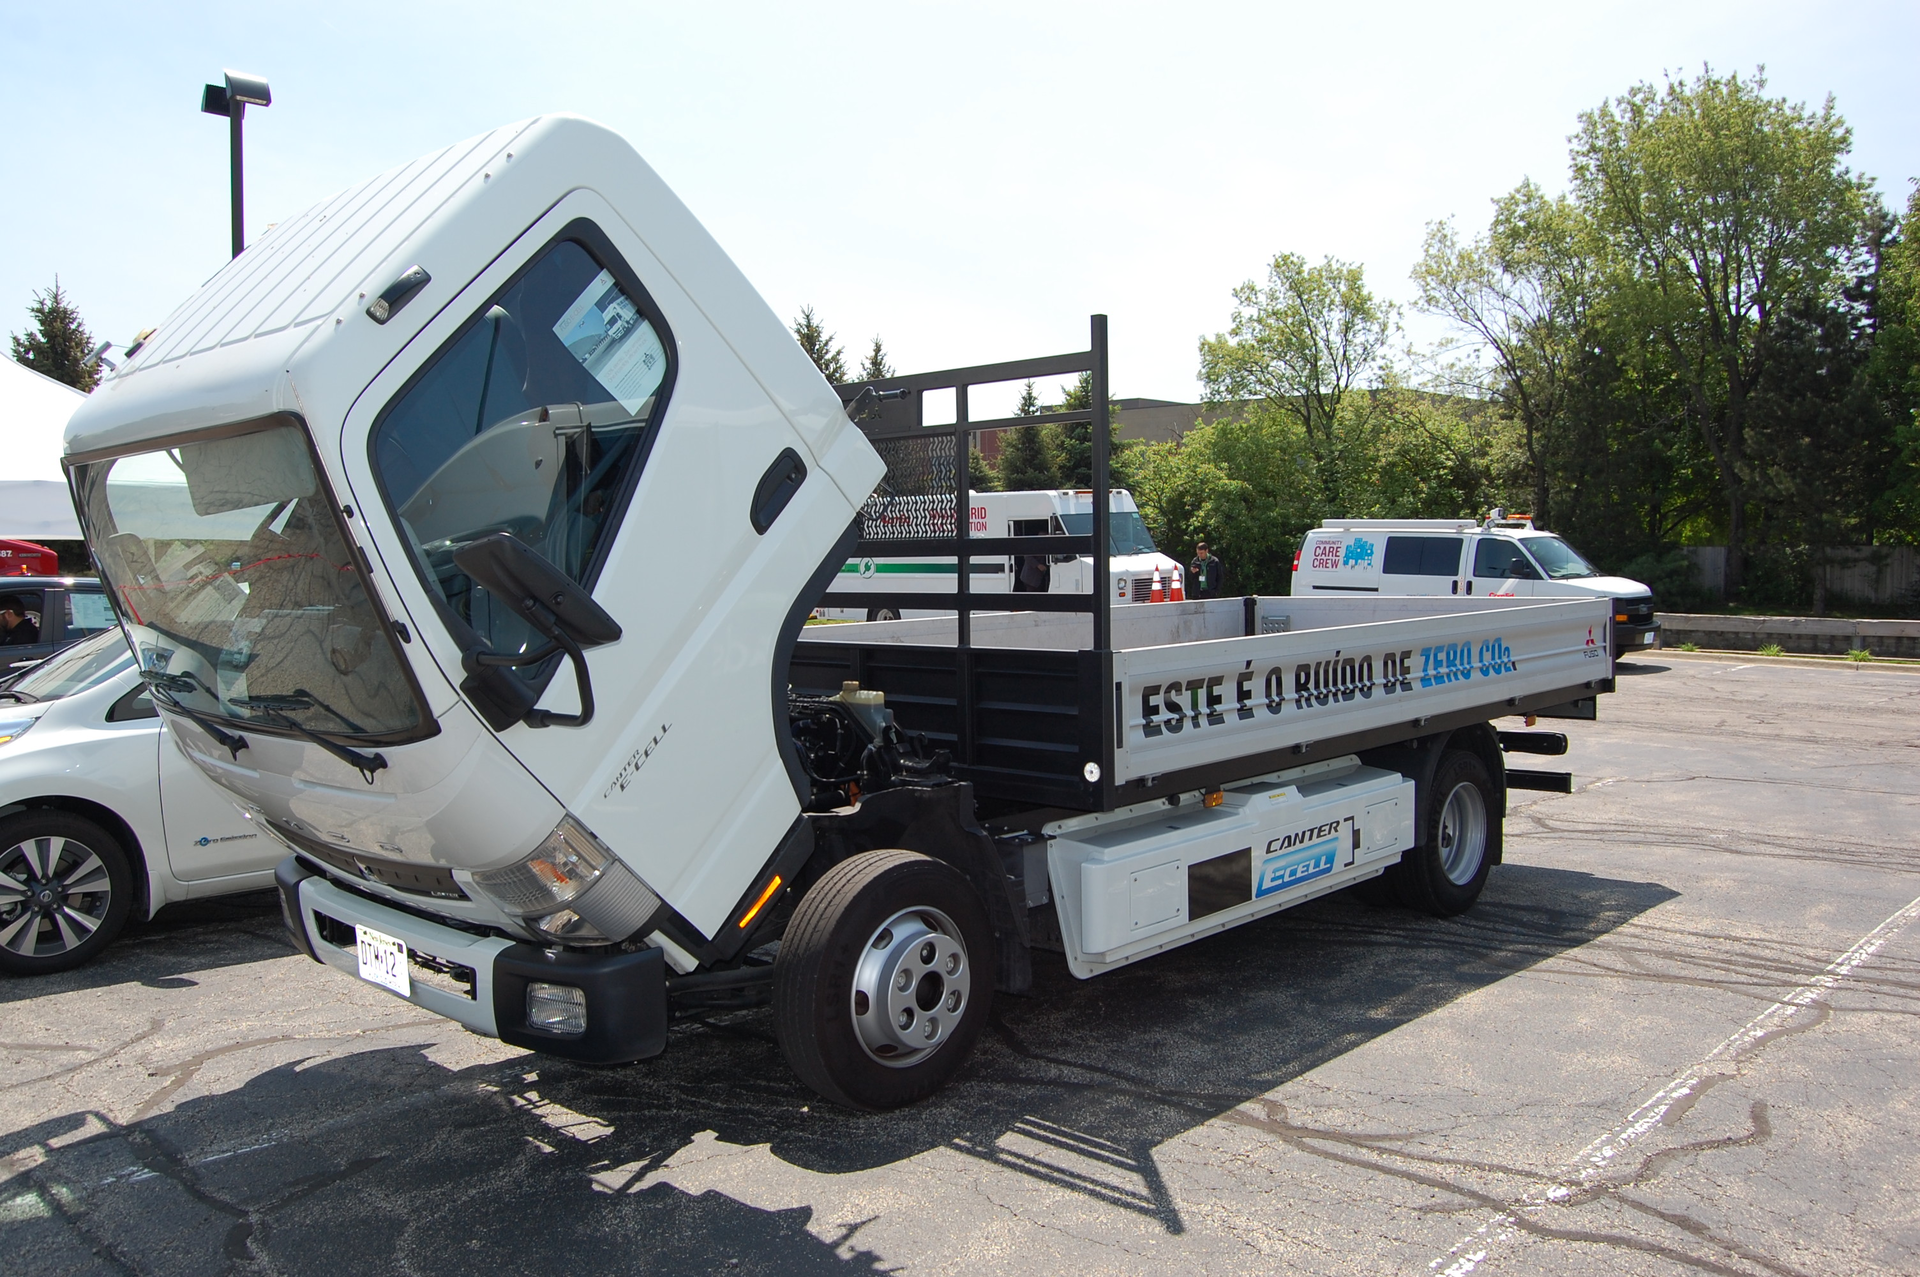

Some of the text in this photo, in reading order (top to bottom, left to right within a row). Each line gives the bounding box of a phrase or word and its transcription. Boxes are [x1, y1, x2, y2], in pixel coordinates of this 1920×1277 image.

[1312, 557, 1340, 569] CREW
[1313, 545, 1342, 558] CARE
[1582, 648, 1599, 660] FUSO
[1142, 674, 1226, 739] ESTE
[1236, 659, 1256, 722] É
[1264, 666, 1283, 715] O
[1294, 649, 1374, 710] RUÍDO
[1383, 649, 1414, 696] DE
[1419, 640, 1473, 688] ZERO
[603, 749, 640, 800] CANTER
[619, 722, 673, 793] E-CELL
[1265, 819, 1341, 854] CANTER
